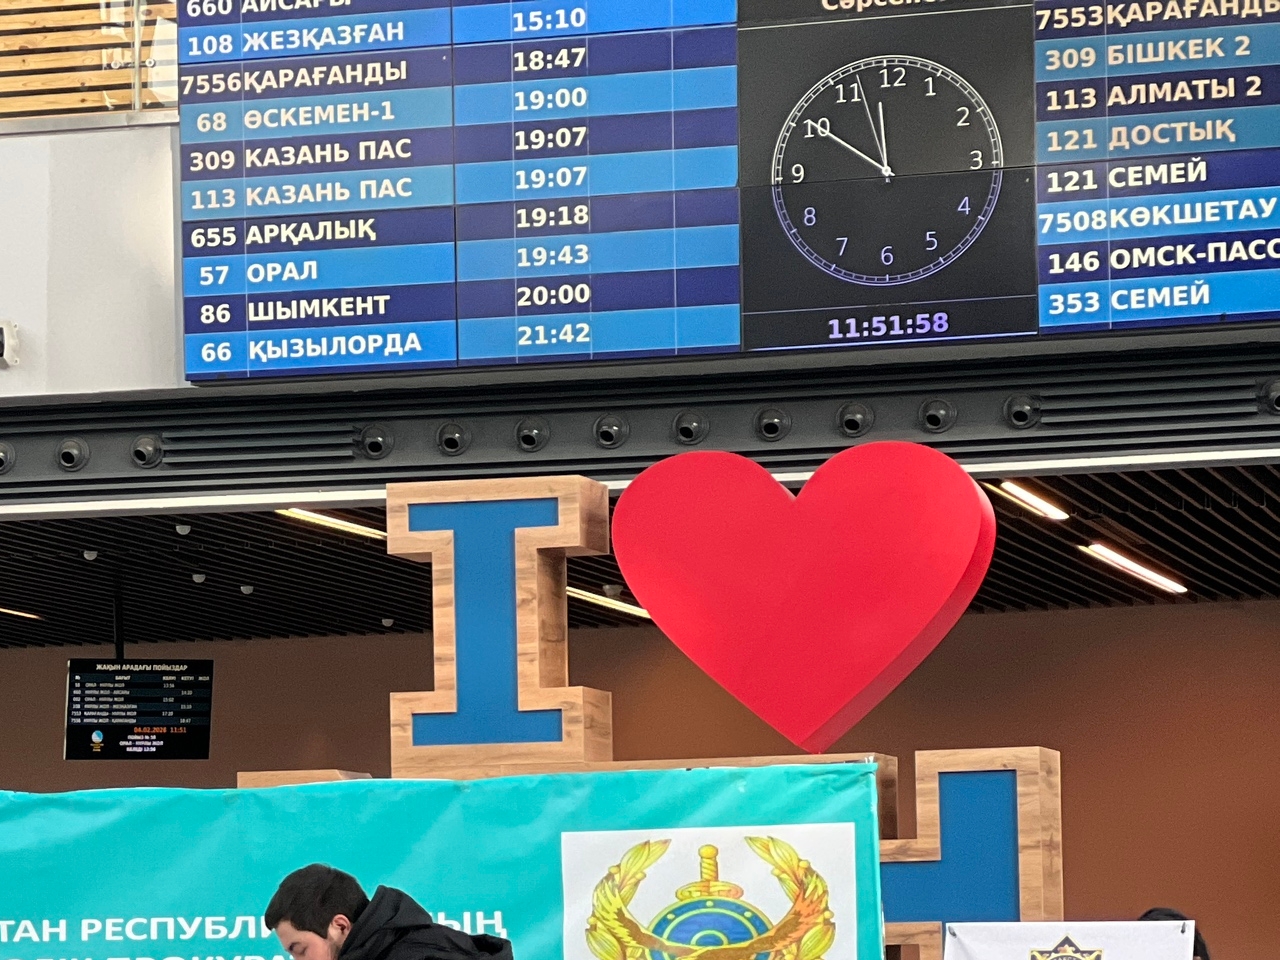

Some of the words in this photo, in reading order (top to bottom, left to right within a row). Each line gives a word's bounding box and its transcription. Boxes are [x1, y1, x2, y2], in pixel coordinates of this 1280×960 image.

[187, 35, 234, 56] 108
[242, 22, 405, 53] ЖЕЗҚАЗҒАН
[512, 8, 587, 32] 15:10
[1035, 8, 1104, 31] 7553
[1045, 47, 1097, 71] 309
[1107, 37, 1226, 66] БІШКЕК
[1234, 35, 1252, 56] 2
[180, 73, 242, 95] 7556
[243, 61, 408, 94] ҚАРАҒАНДЫ
[513, 48, 588, 72] 18:47
[878, 67, 907, 89] 12
[835, 83, 862, 105] 11
[924, 77, 937, 97] 1
[1046, 88, 1097, 111] 113
[1107, 77, 1237, 107] АЛМАТЫ
[1245, 75, 1263, 97] 2
[196, 112, 228, 133] 68
[243, 101, 396, 130] ӨСКЕМЕН-1
[513, 87, 589, 112] 19:00
[956, 107, 970, 128] 2
[803, 118, 831, 139] 10
[1046, 129, 1098, 152] 121
[1108, 119, 1236, 151] ДОСТЫҚ
[189, 150, 236, 172] 309
[245, 143, 350, 169] КАЗАНЬ
[358, 138, 413, 162] ПАС
[514, 126, 589, 151] 19:07
[969, 151, 983, 171] 3
[190, 189, 237, 209] 113
[245, 182, 350, 207] КАЗАНЬ
[359, 178, 413, 201] ПАС
[515, 166, 589, 190] 19:07
[791, 164, 805, 183] 9
[1047, 170, 1099, 193] 121
[1108, 157, 1208, 189] СЕМЕЙ
[803, 206, 817, 226] 8
[957, 196, 972, 216] 4
[1039, 210, 1108, 234] 7508
[1109, 197, 1278, 229] КӨКШЕТАУ
[190, 227, 237, 249] 655
[245, 219, 377, 246] АРҚАЛЫҚ
[516, 205, 590, 230] 19:18
[925, 231, 938, 251] 5
[836, 237, 849, 256] 7
[881, 245, 895, 266] 6
[199, 265, 230, 286] 57
[247, 261, 318, 283] ОРАЛ
[517, 245, 590, 269] 19:43
[1048, 251, 1100, 274] 146
[199, 304, 232, 325] 86
[247, 295, 391, 322] ШЫМКЕНТ
[517, 284, 591, 308] 20:00
[1049, 292, 1101, 315] 353
[1111, 280, 1210, 311] СЕМЕЙ
[828, 312, 949, 339] 11:51:58
[201, 342, 232, 363] 66
[248, 332, 422, 362] ҚЫЗЫЛОРДА
[518, 324, 591, 348] 21:42
